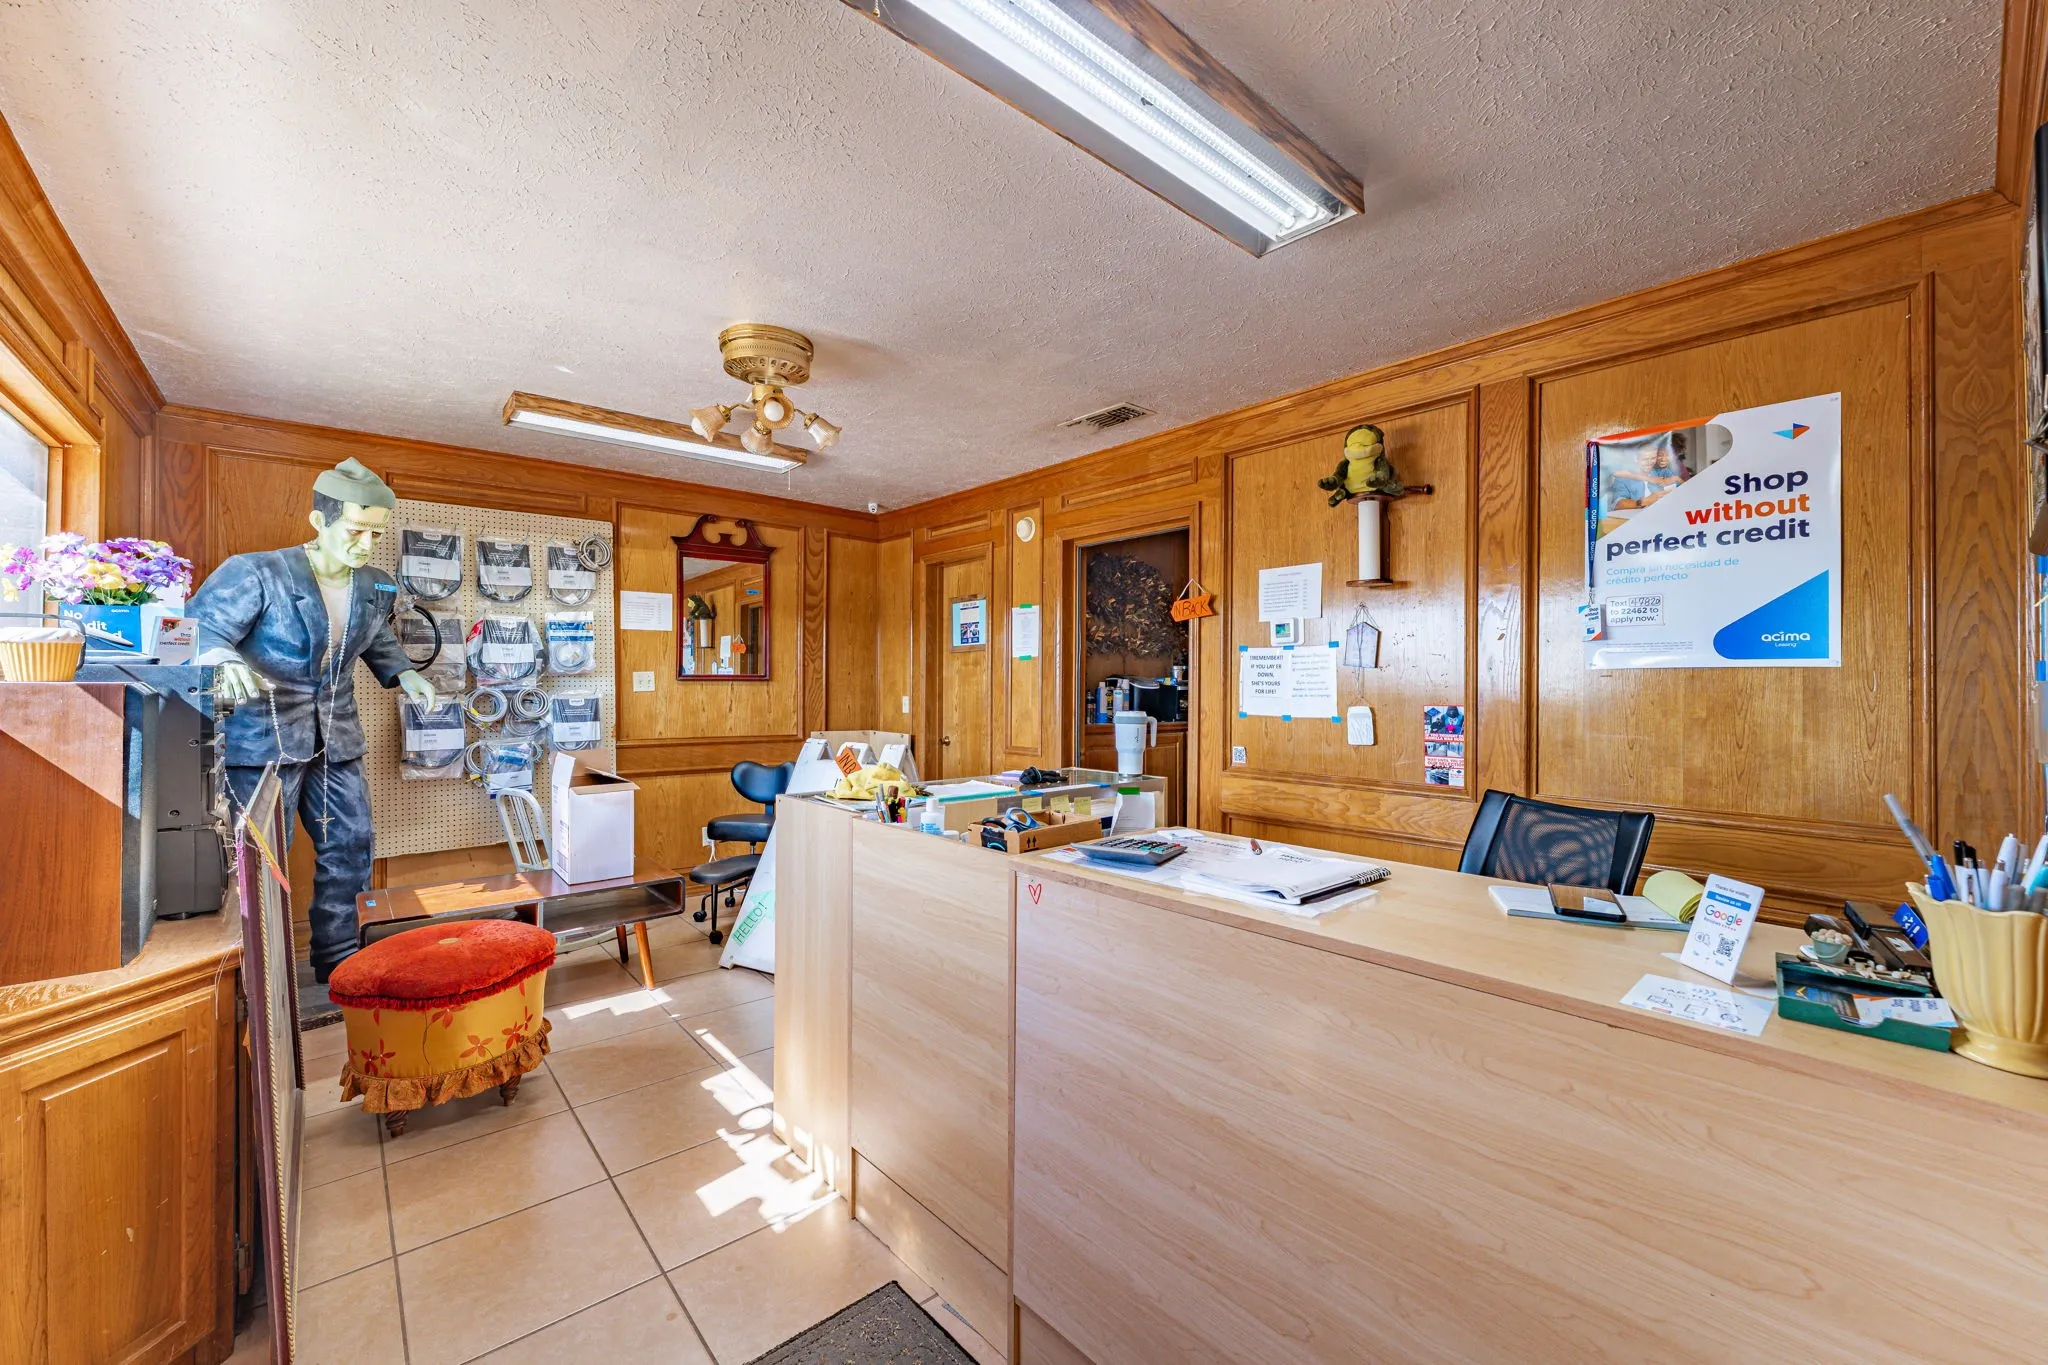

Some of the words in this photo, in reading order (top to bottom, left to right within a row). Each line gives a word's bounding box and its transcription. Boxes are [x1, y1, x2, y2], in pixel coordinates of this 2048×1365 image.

[1724, 470, 1808, 495] Shop
[1685, 494, 1810, 526] without
[1606, 530, 1707, 561] perfect
[1716, 518, 1810, 546] credit
[1606, 566, 1646, 577] Compra
[1724, 557, 1740, 566] de
[1643, 572, 1688, 584] perfecto
[63, 610, 83, 620] No
[1182, 600, 1208, 617] BACK
[1761, 631, 1810, 642] acima
[734, 902, 767, 943] HELLO!
[1705, 905, 1742, 925] Google
